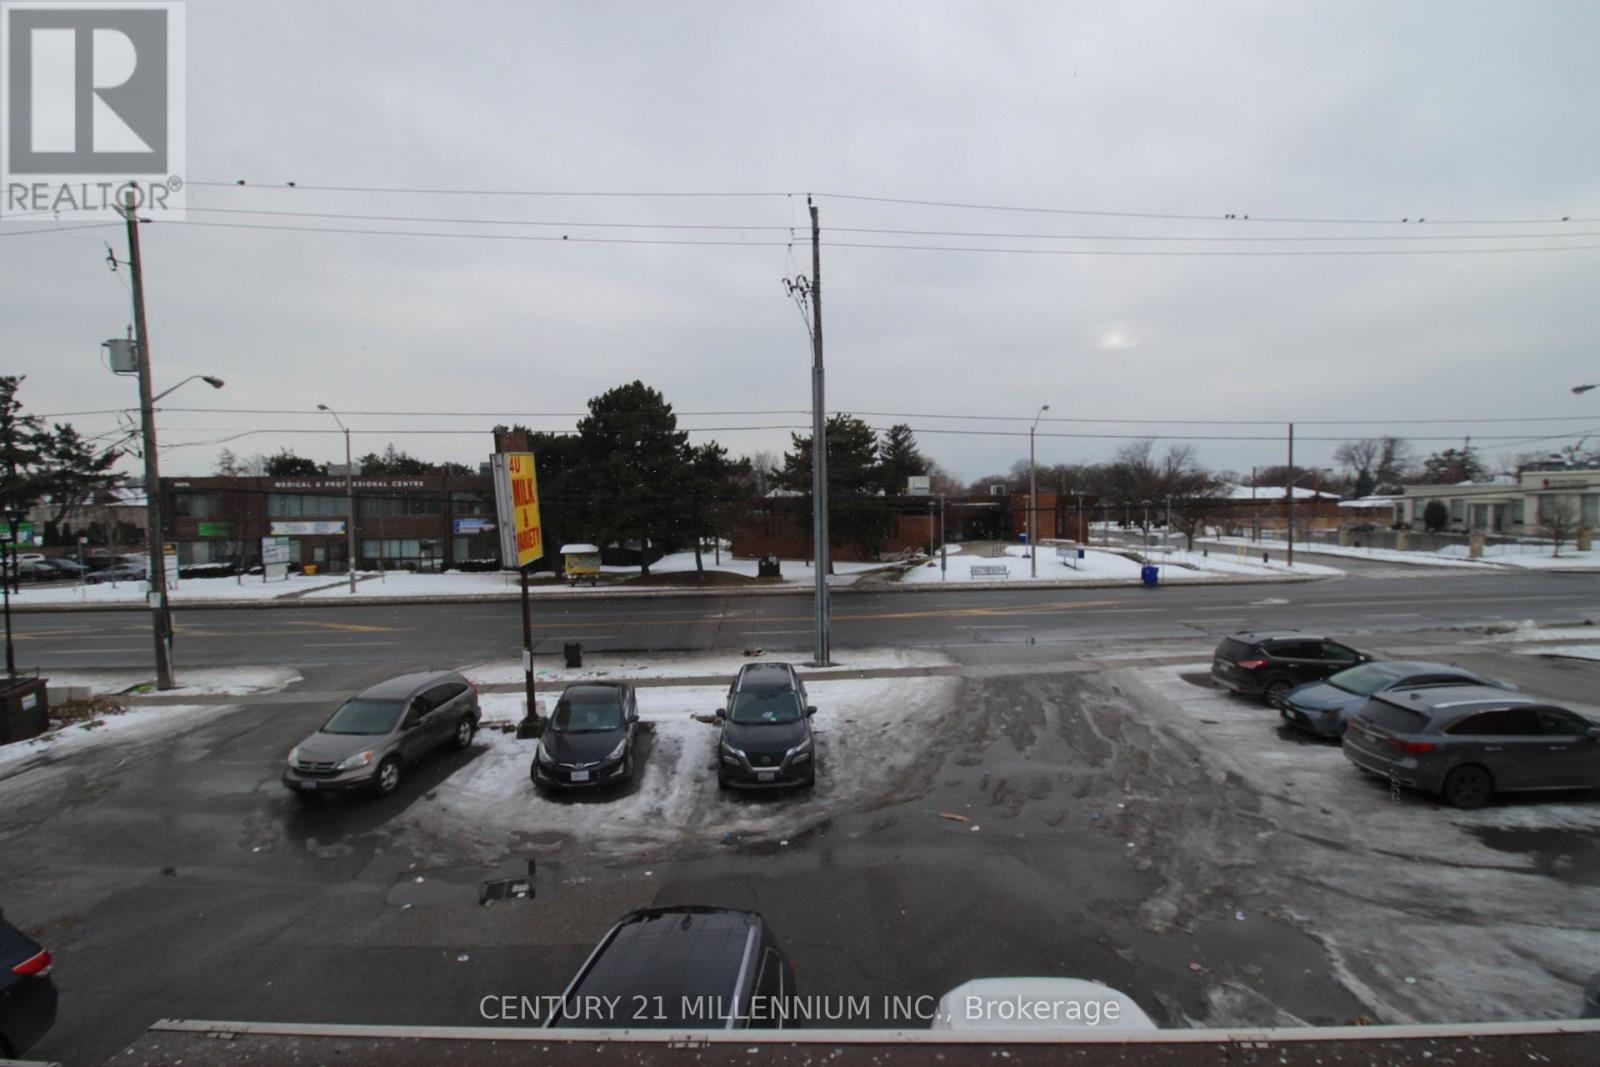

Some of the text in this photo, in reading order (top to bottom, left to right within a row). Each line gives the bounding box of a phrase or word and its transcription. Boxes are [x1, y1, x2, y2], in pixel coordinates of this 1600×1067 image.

[510, 457, 520, 473] 4U
[325, 480, 388, 488] PROFSSIONAL
[391, 480, 424, 488] CENTRE
[513, 478, 535, 507] MILK
